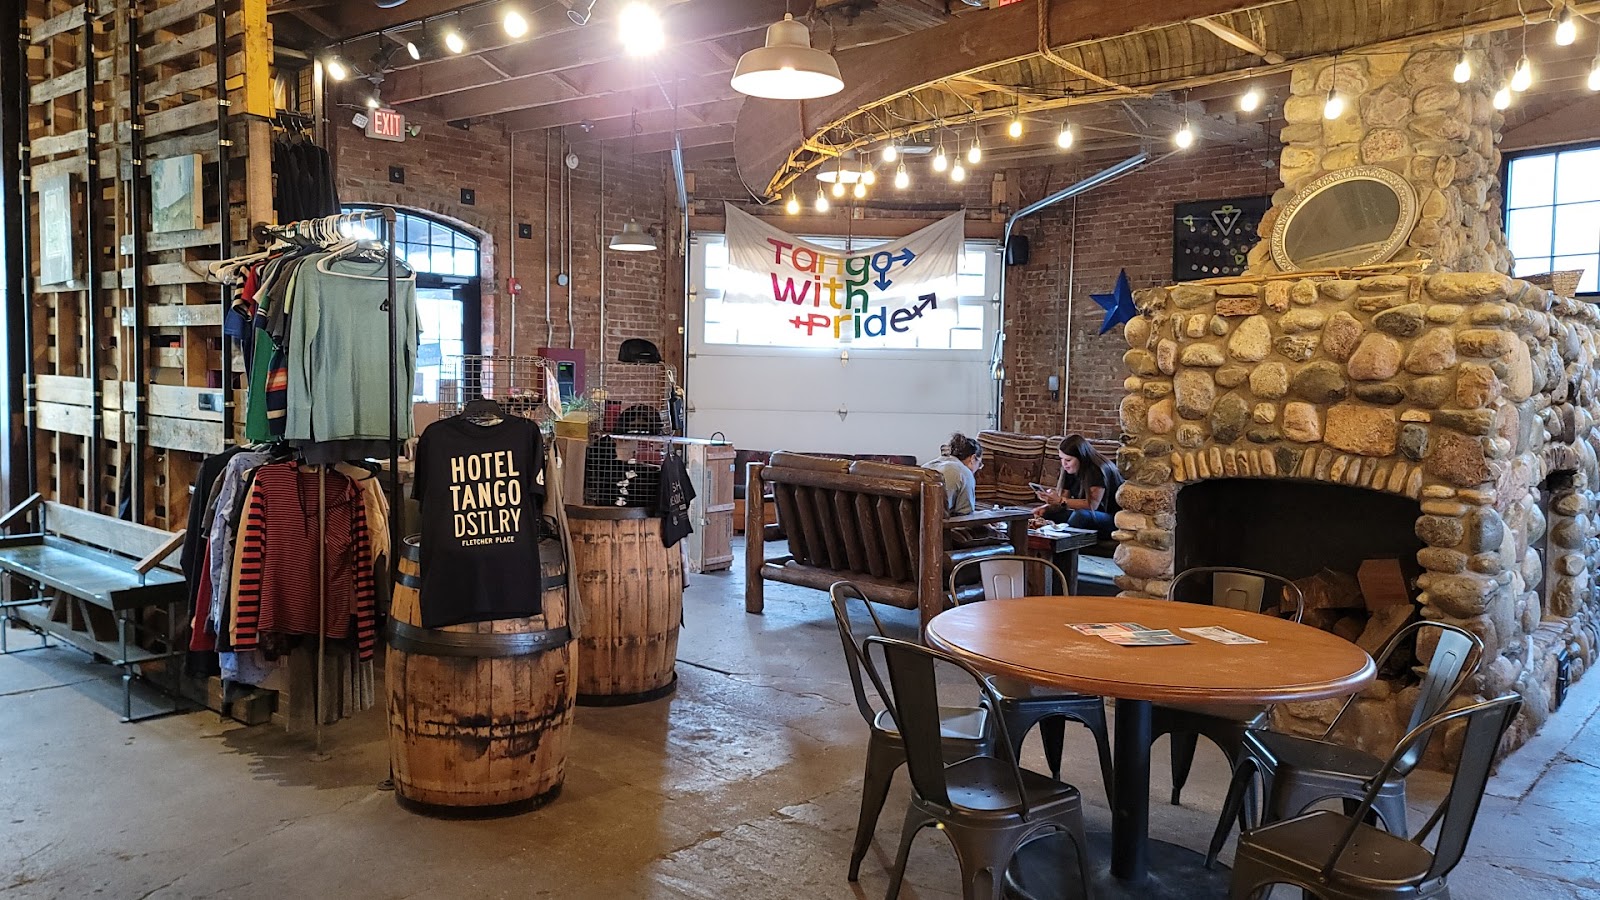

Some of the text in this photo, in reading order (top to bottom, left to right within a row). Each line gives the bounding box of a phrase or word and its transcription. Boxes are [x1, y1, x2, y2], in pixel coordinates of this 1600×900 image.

[374, 111, 401, 137] EXIT
[767, 237, 893, 287] Tango
[450, 450, 520, 483] HOTEL
[449, 479, 521, 511] TANGO
[454, 507, 521, 538] DSTLRY
[462, 536, 515, 547] FLETCHER PLACE
